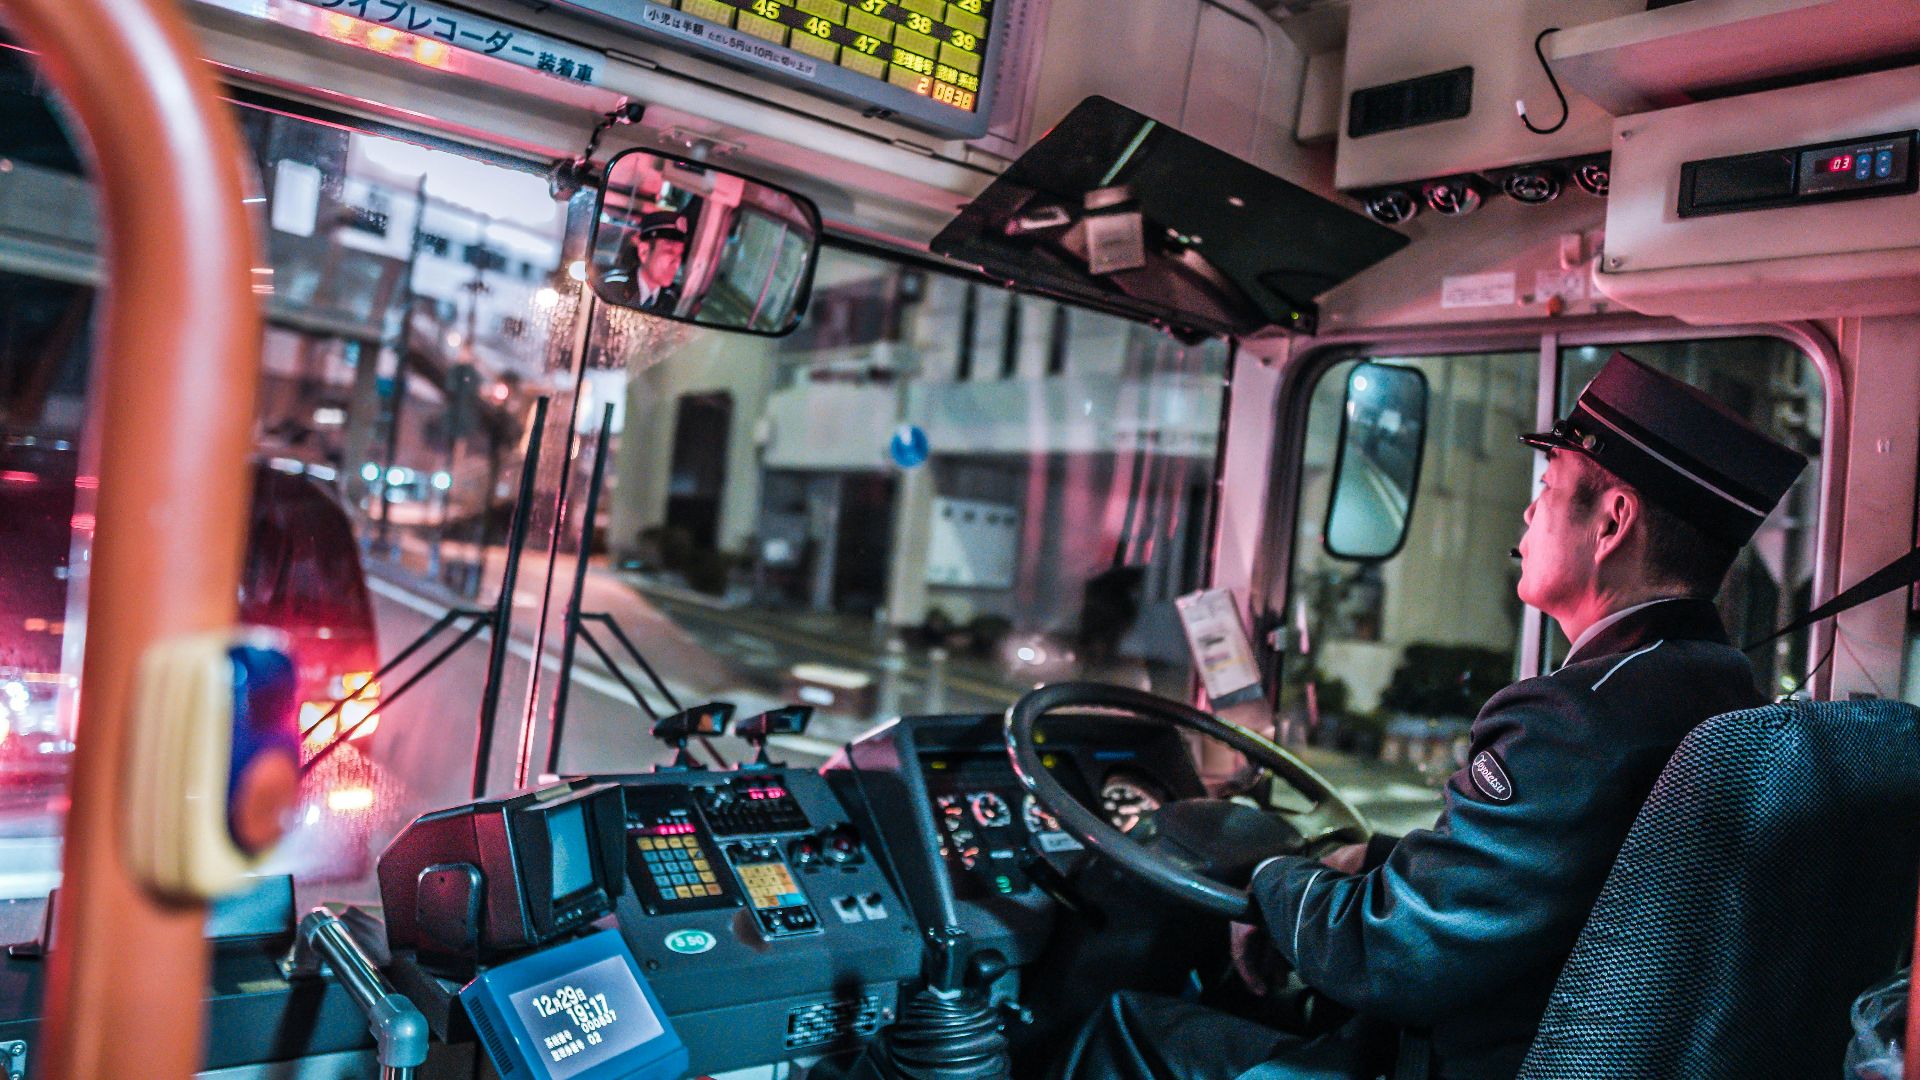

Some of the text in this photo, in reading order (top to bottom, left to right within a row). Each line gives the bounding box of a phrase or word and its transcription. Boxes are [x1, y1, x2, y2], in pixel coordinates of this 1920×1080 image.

[752, 0, 781, 19] 45
[860, 0, 888, 15] 37
[957, 0, 982, 13] 29
[648, 9, 704, 37] 小児は半額
[804, 16, 831, 38] 46
[906, 12, 932, 34] 38
[853, 34, 881, 55] 47
[951, 29, 976, 51] 39
[917, 77, 930, 94] 2
[1833, 156, 1849, 170] 03
[533, 985, 587, 1018] 12月29日
[566, 993, 609, 1026] 19:17
[586, 1031, 602, 1046] 02
